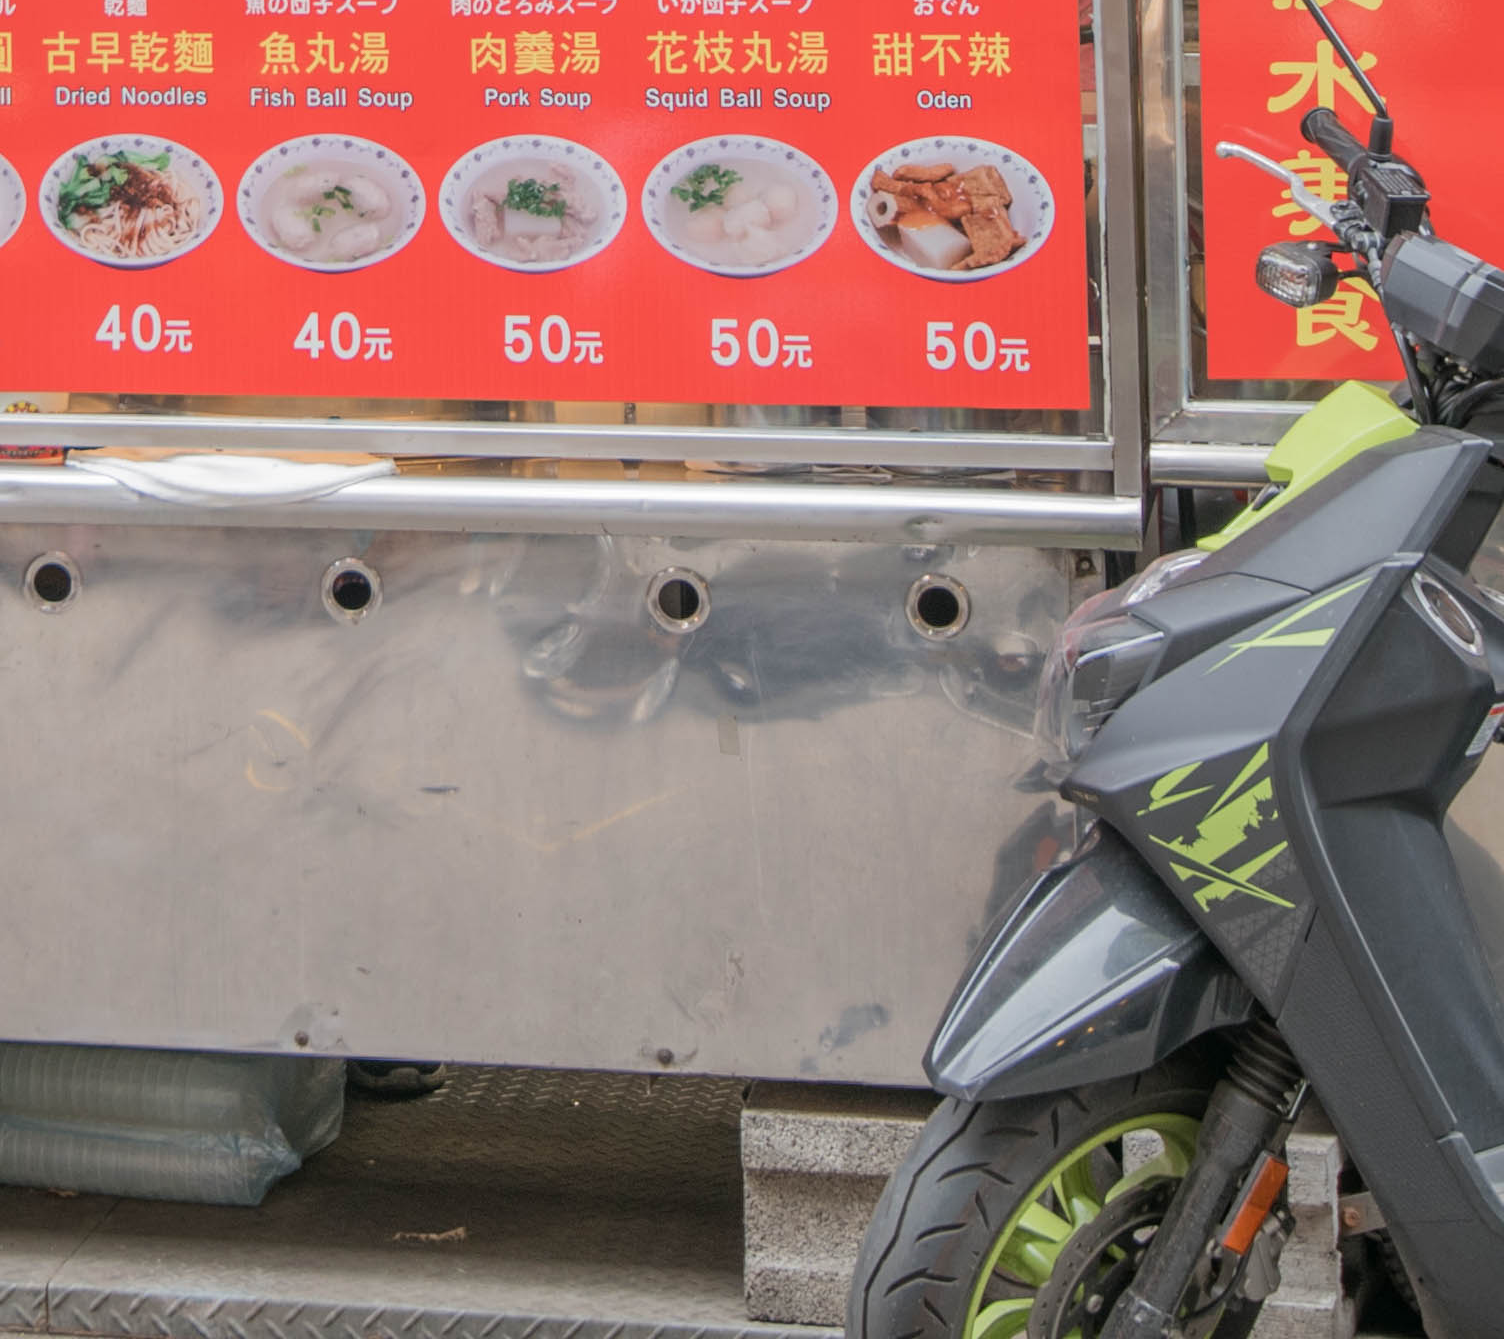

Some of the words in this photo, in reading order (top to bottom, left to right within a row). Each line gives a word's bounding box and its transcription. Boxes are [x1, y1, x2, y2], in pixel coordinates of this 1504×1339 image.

[42, 30, 215, 76] 古早乾麵
[259, 30, 390, 76] 魚丸湯
[470, 30, 601, 76] 肉羹湯
[646, 30, 829, 76] 花枝丸湯
[872, 32, 1013, 77] 甜不辣
[55, 86, 111, 106] Dried
[120, 86, 208, 106] Noodles
[249, 87, 296, 108] Fish
[305, 87, 348, 108] Ball
[357, 87, 414, 111] Soup
[484, 88, 530, 108] Pork
[539, 88, 592, 110] Soup
[645, 88, 710, 112] Squid
[720, 88, 762, 109] Ball
[774, 88, 832, 112] Soup
[916, 90, 973, 110] Oden
[95, 304, 193, 353] 40元
[294, 311, 393, 361] 40元
[503, 315, 604, 365] 50元
[710, 318, 813, 369] 50元
[925, 321, 1031, 373] 50元
